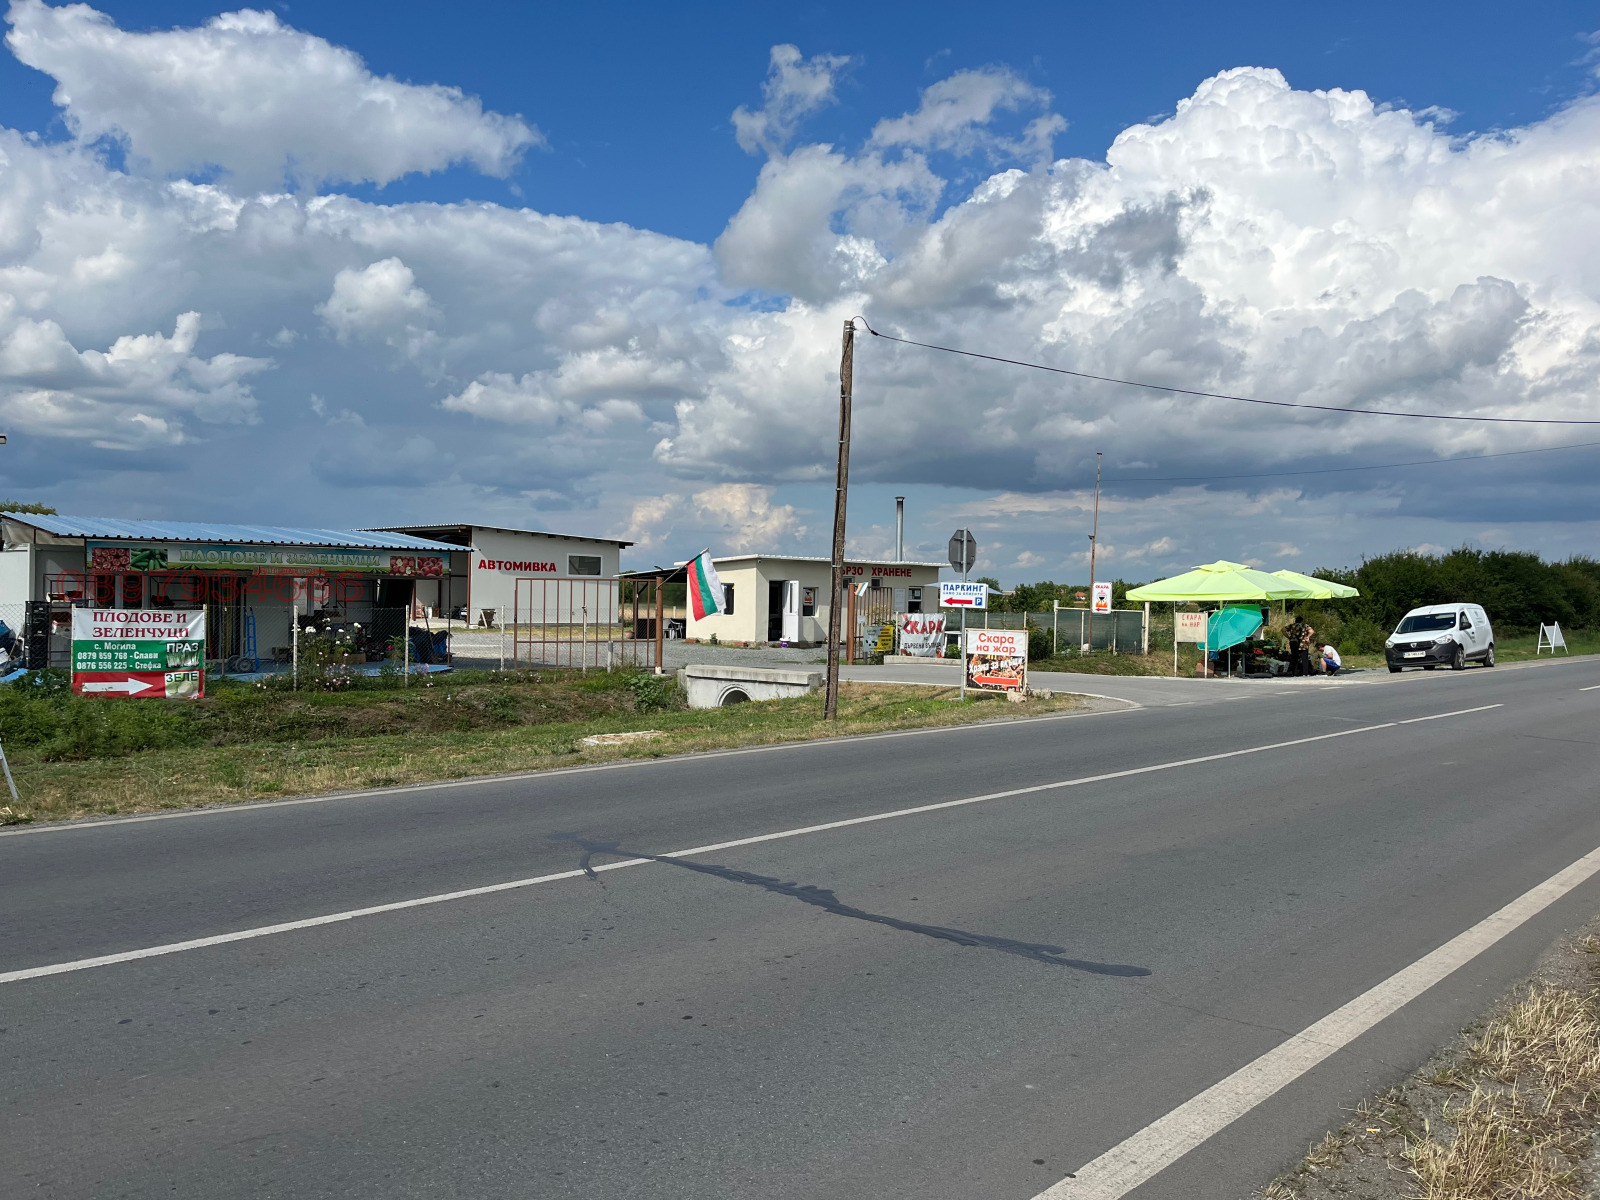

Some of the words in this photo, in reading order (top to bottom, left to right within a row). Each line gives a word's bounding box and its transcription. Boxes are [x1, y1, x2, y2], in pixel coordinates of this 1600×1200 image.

[180, 549, 267, 564] ПЛОДОВЕ
[270, 552, 283, 564] И
[286, 552, 381, 567] ЗЕЛЕНЧУЦИ
[478, 559, 557, 572] АВТОМИВКА
[871, 566, 912, 577] ХРАНЕНЕ
[943, 584, 984, 592] ПАРКИНГ
[93, 612, 173, 624] ПЛОДОВЕ
[176, 613, 187, 623] И
[1181, 613, 1202, 621] СКАРА
[92, 627, 190, 638] ЗЕЛЕНЧУЦИ
[978, 633, 1015, 646] Скара
[104, 642, 136, 650] Могила
[166, 642, 199, 653] ПРАЗ
[993, 646, 1016, 655] жар
[77, 652, 97, 660] 0879
[114, 652, 128, 660] 768
[76, 662, 97, 670] 0876
[98, 662, 112, 670] 556
[113, 662, 127, 670] 225
[135, 661, 162, 670] Стефка
[165, 672, 198, 683] ЗЕЛЕ
